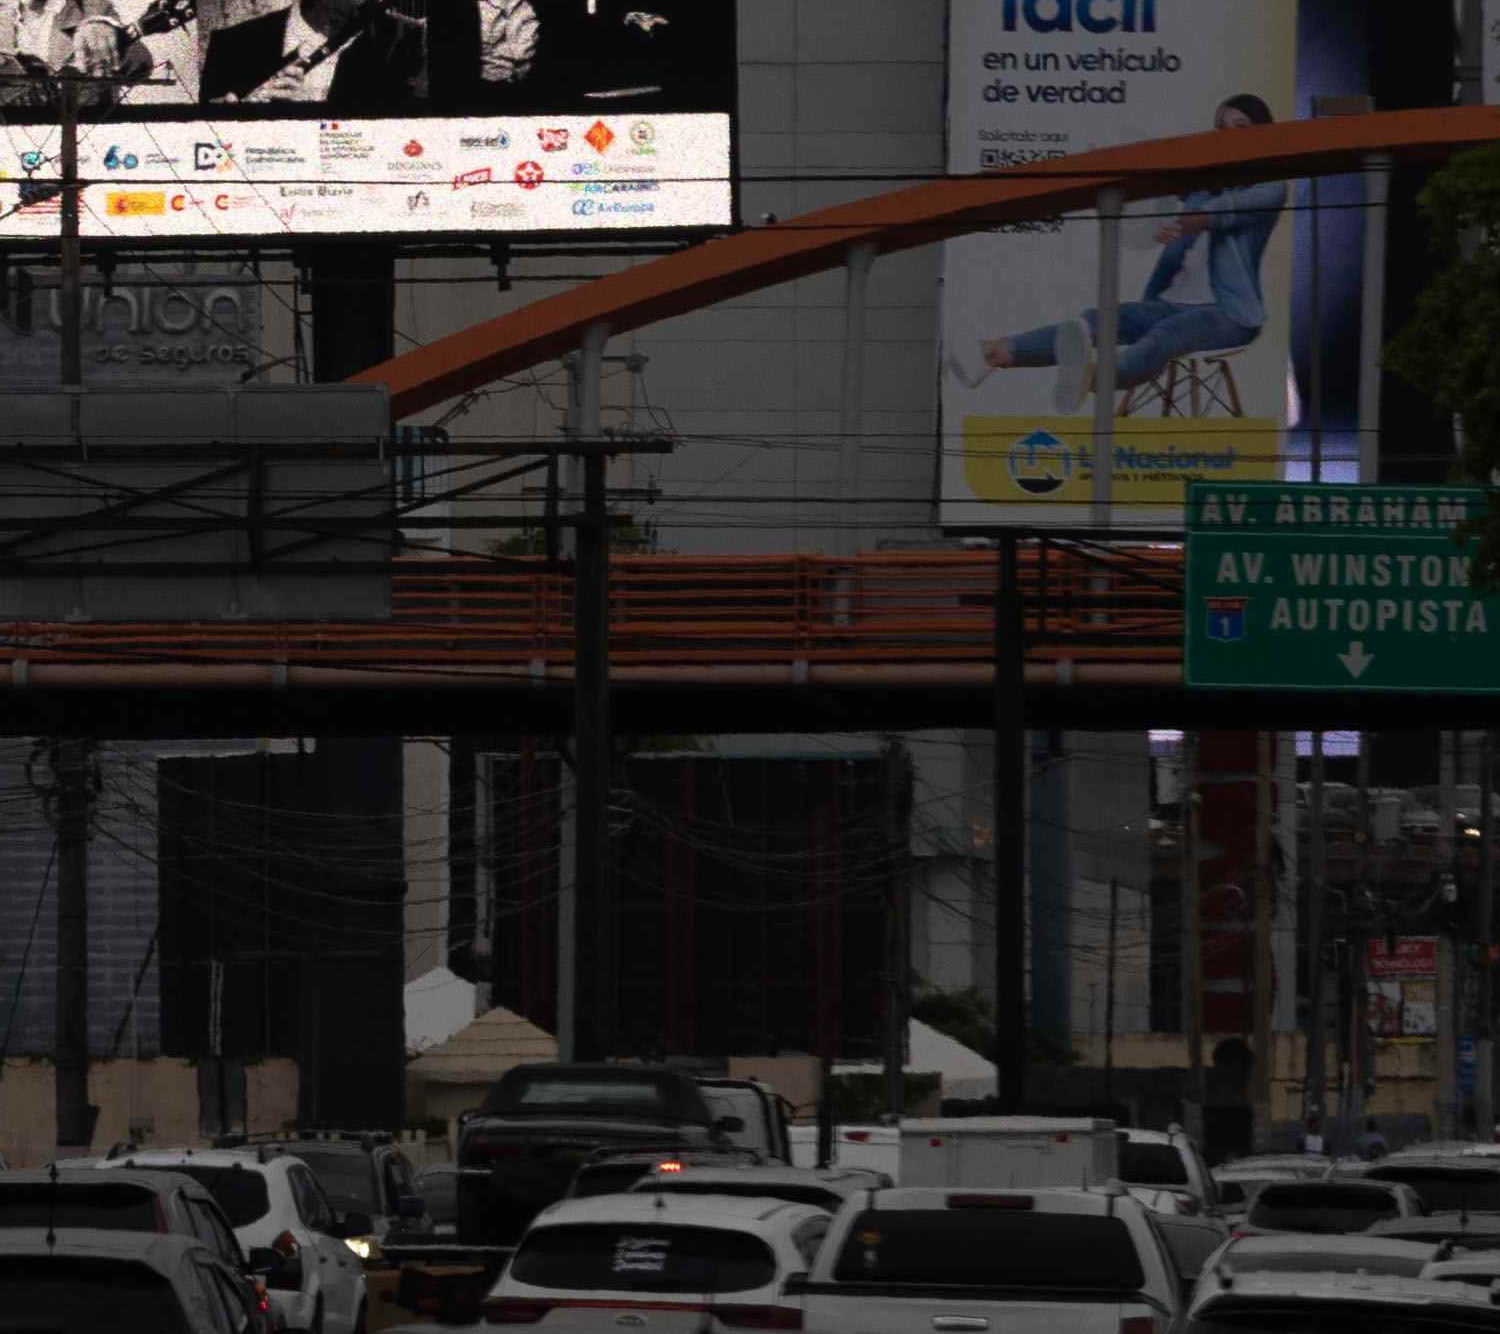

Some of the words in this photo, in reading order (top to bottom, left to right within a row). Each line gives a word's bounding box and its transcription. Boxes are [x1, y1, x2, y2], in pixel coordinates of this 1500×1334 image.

[982, 51, 1017, 71] en
[1024, 52, 1060, 72] un
[1065, 46, 1181, 73] vehículo
[982, 78, 1019, 103] de
[1025, 80, 1127, 104] verdad
[96, 345, 129, 364] de
[137, 345, 250, 371] seguros
[1202, 493, 1256, 525] AV.
[1275, 494, 1467, 529] ABRAHAM
[1216, 552, 1273, 585] AV.
[1290, 553, 1472, 587] WINSTON
[1269, 597, 1488, 634] AUTOPISTA
